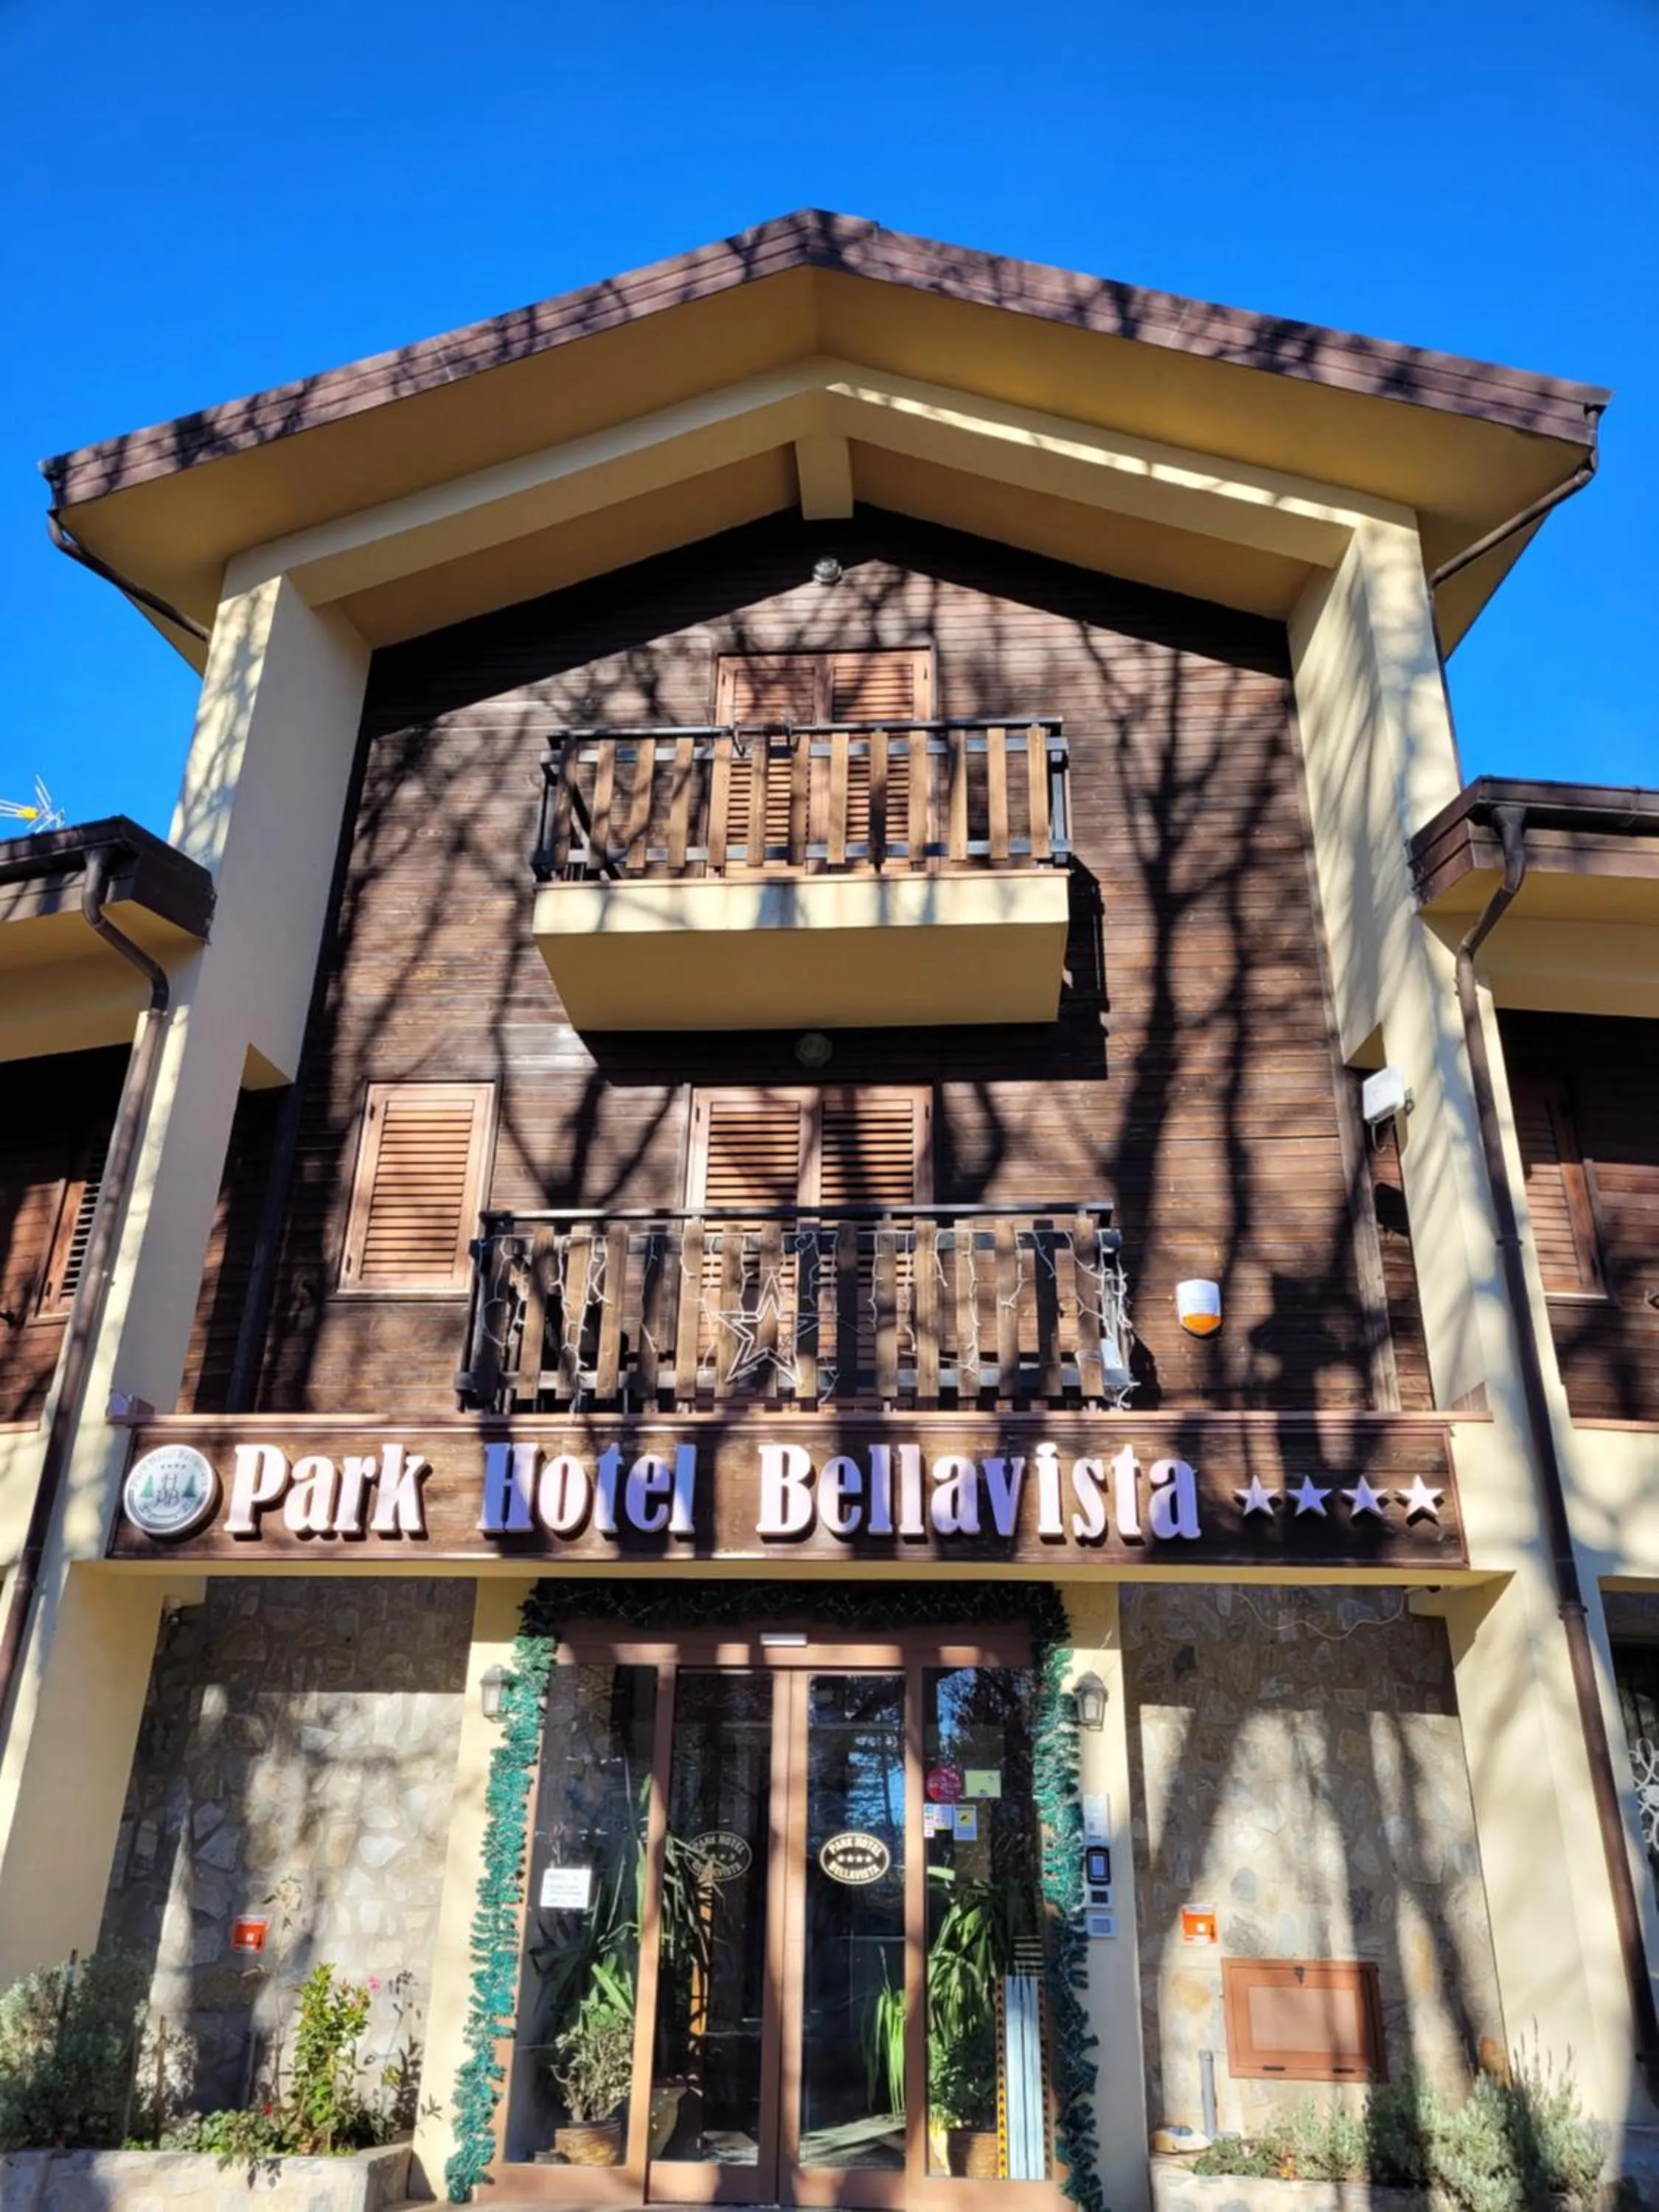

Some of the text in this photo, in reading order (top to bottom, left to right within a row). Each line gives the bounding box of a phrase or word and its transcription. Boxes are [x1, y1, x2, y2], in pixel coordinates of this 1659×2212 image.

[223, 1443, 425, 1533] Park
[476, 1442, 697, 1533] Hotel
[756, 1442, 1202, 1540] Bellavista
[827, 1836, 883, 1857] PARK HOTEL
[828, 1860, 881, 1879] BELLAVISTA
